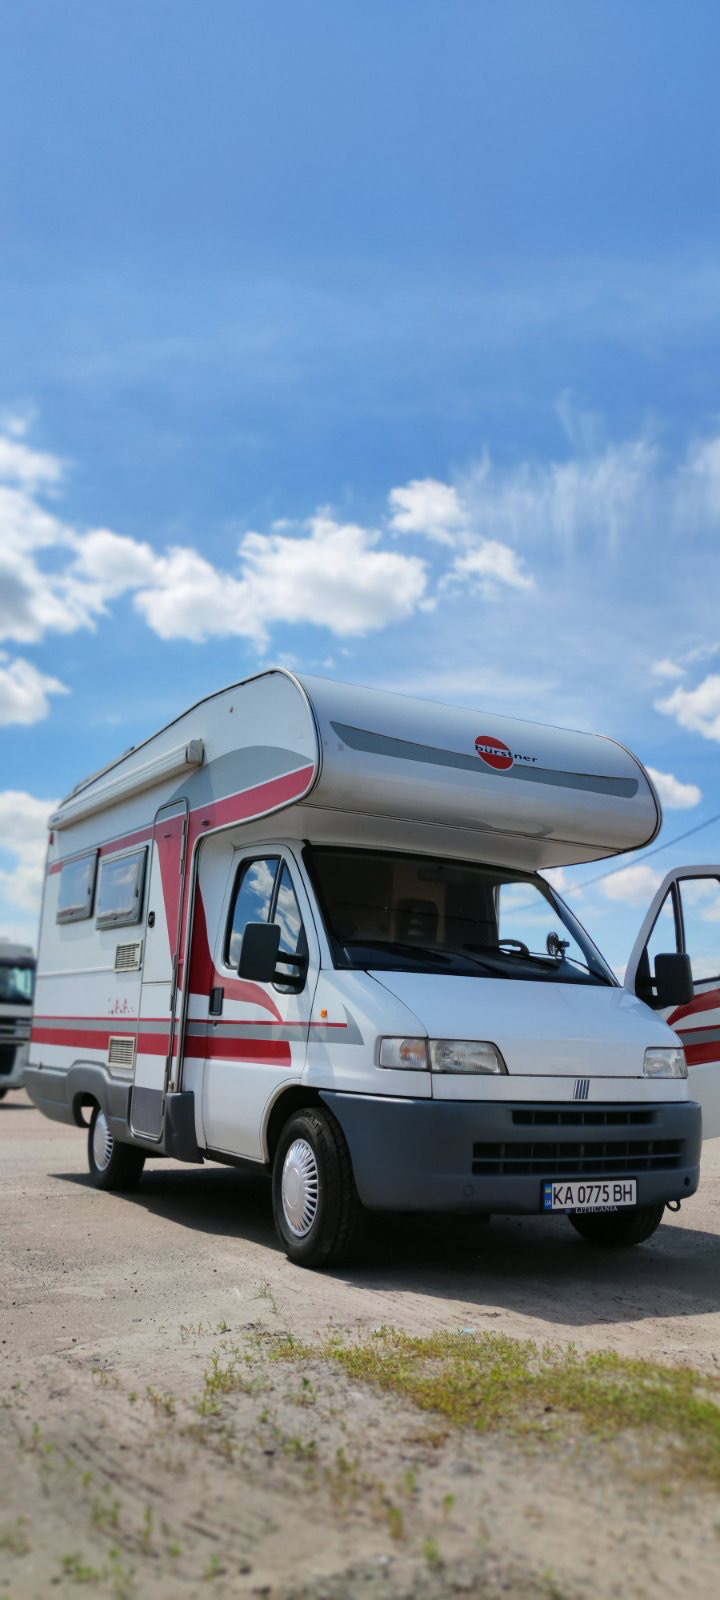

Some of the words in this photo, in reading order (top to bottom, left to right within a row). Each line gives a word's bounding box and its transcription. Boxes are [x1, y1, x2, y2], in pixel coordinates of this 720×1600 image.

[475, 744, 538, 762] bürstner
[553, 1186, 574, 1205] KA
[578, 1185, 610, 1204] 0775
[613, 1184, 632, 1202] BH
